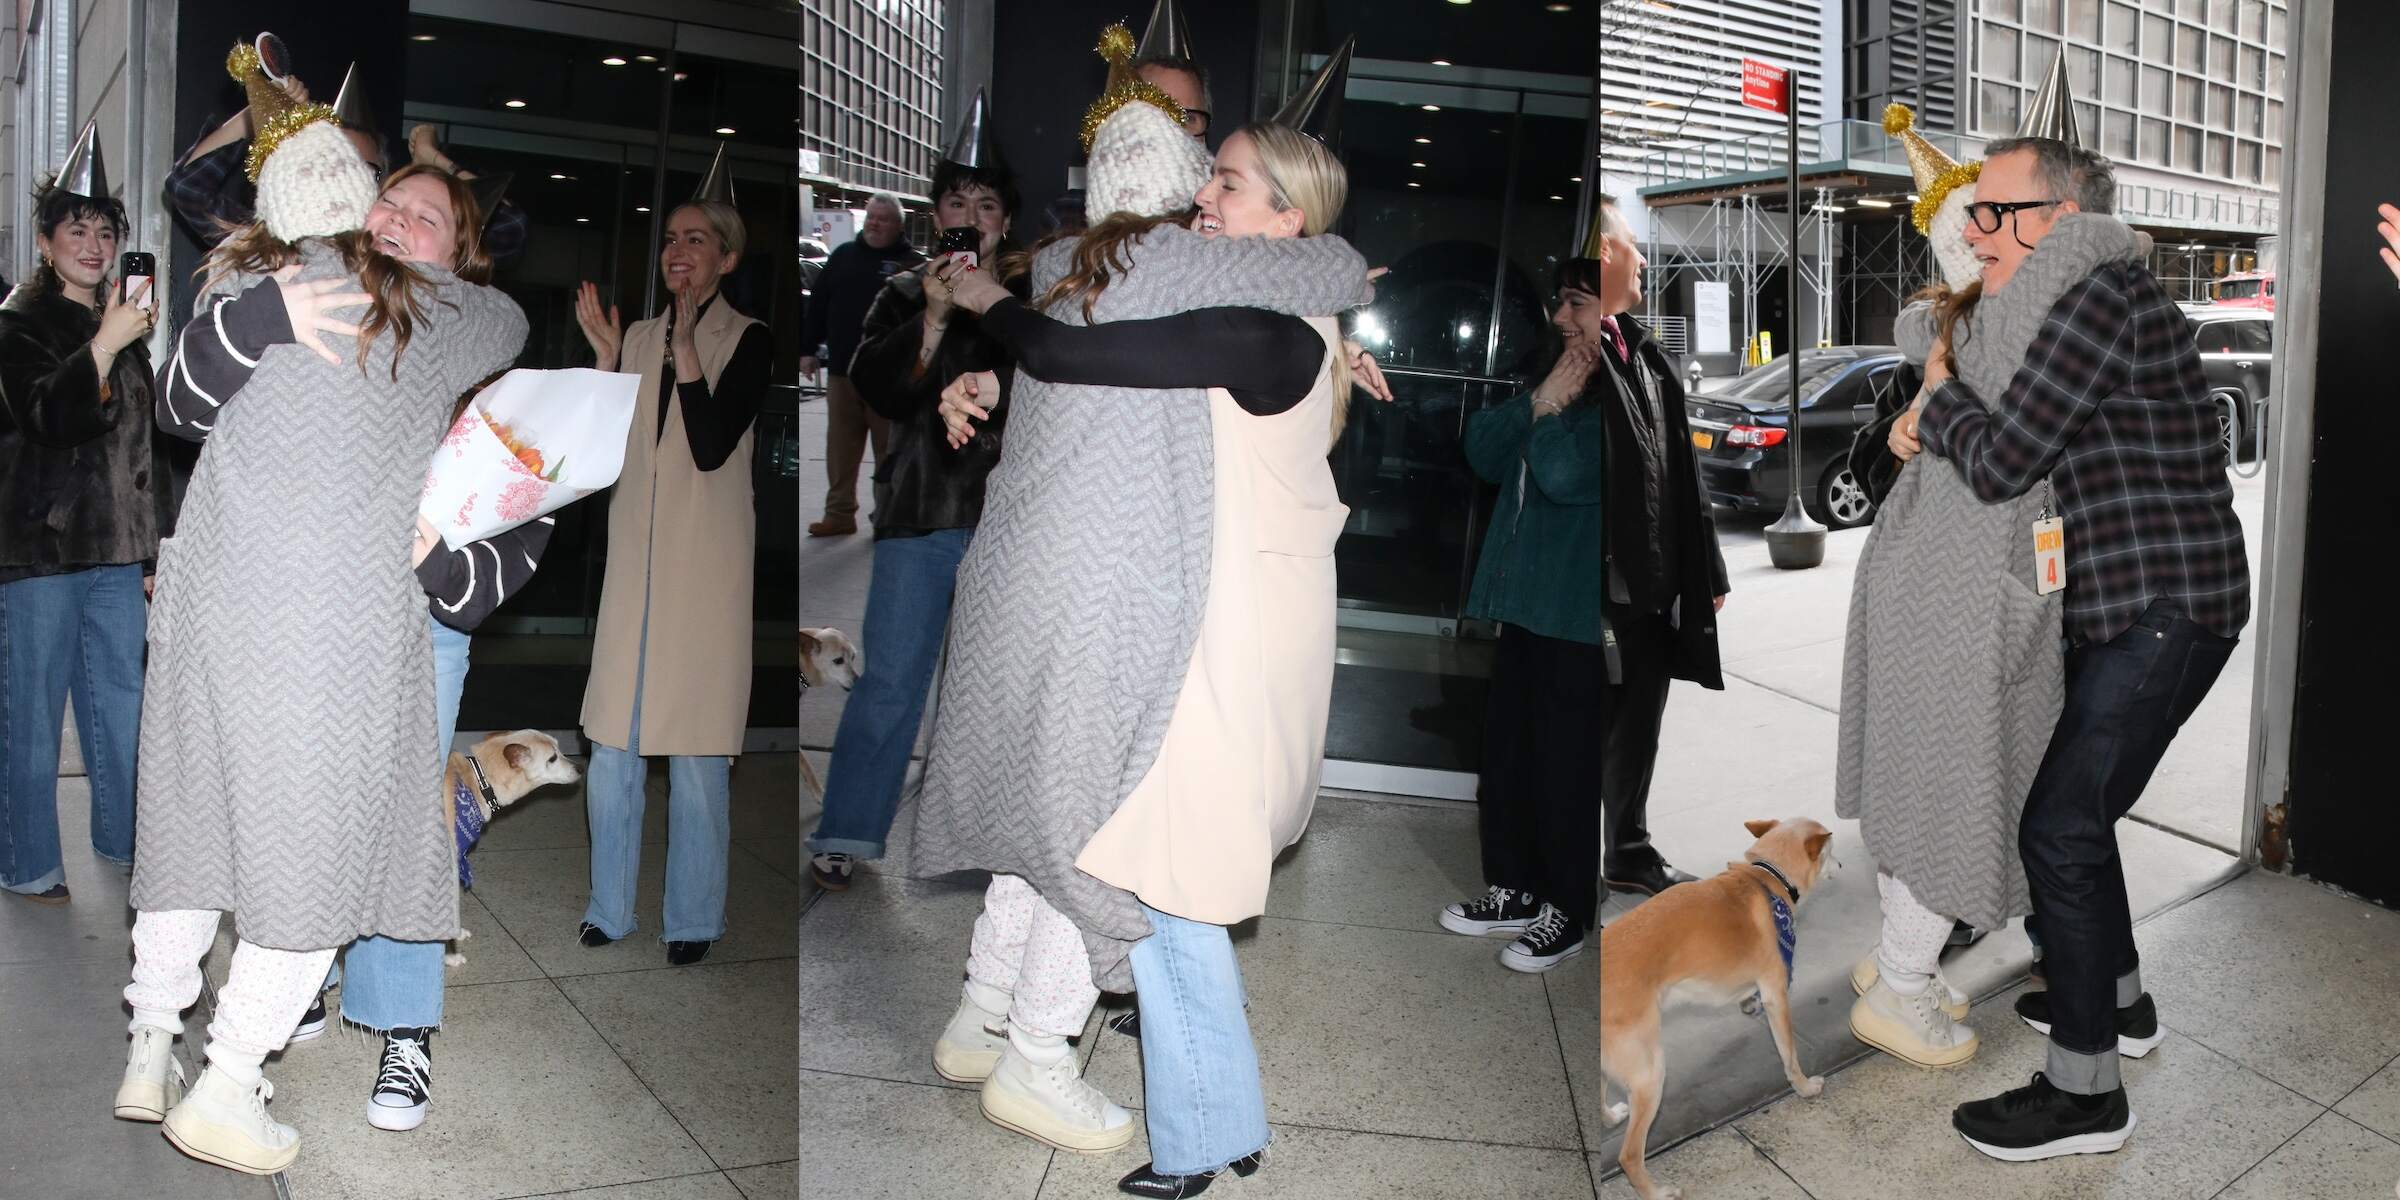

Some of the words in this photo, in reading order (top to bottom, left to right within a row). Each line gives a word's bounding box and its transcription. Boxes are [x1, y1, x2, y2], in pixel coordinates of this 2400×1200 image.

[1744, 61, 1754, 73] NO
[1755, 65, 1783, 82] STANDING
[2037, 529, 2062, 552] DREW
[2047, 557, 2057, 584] 4
